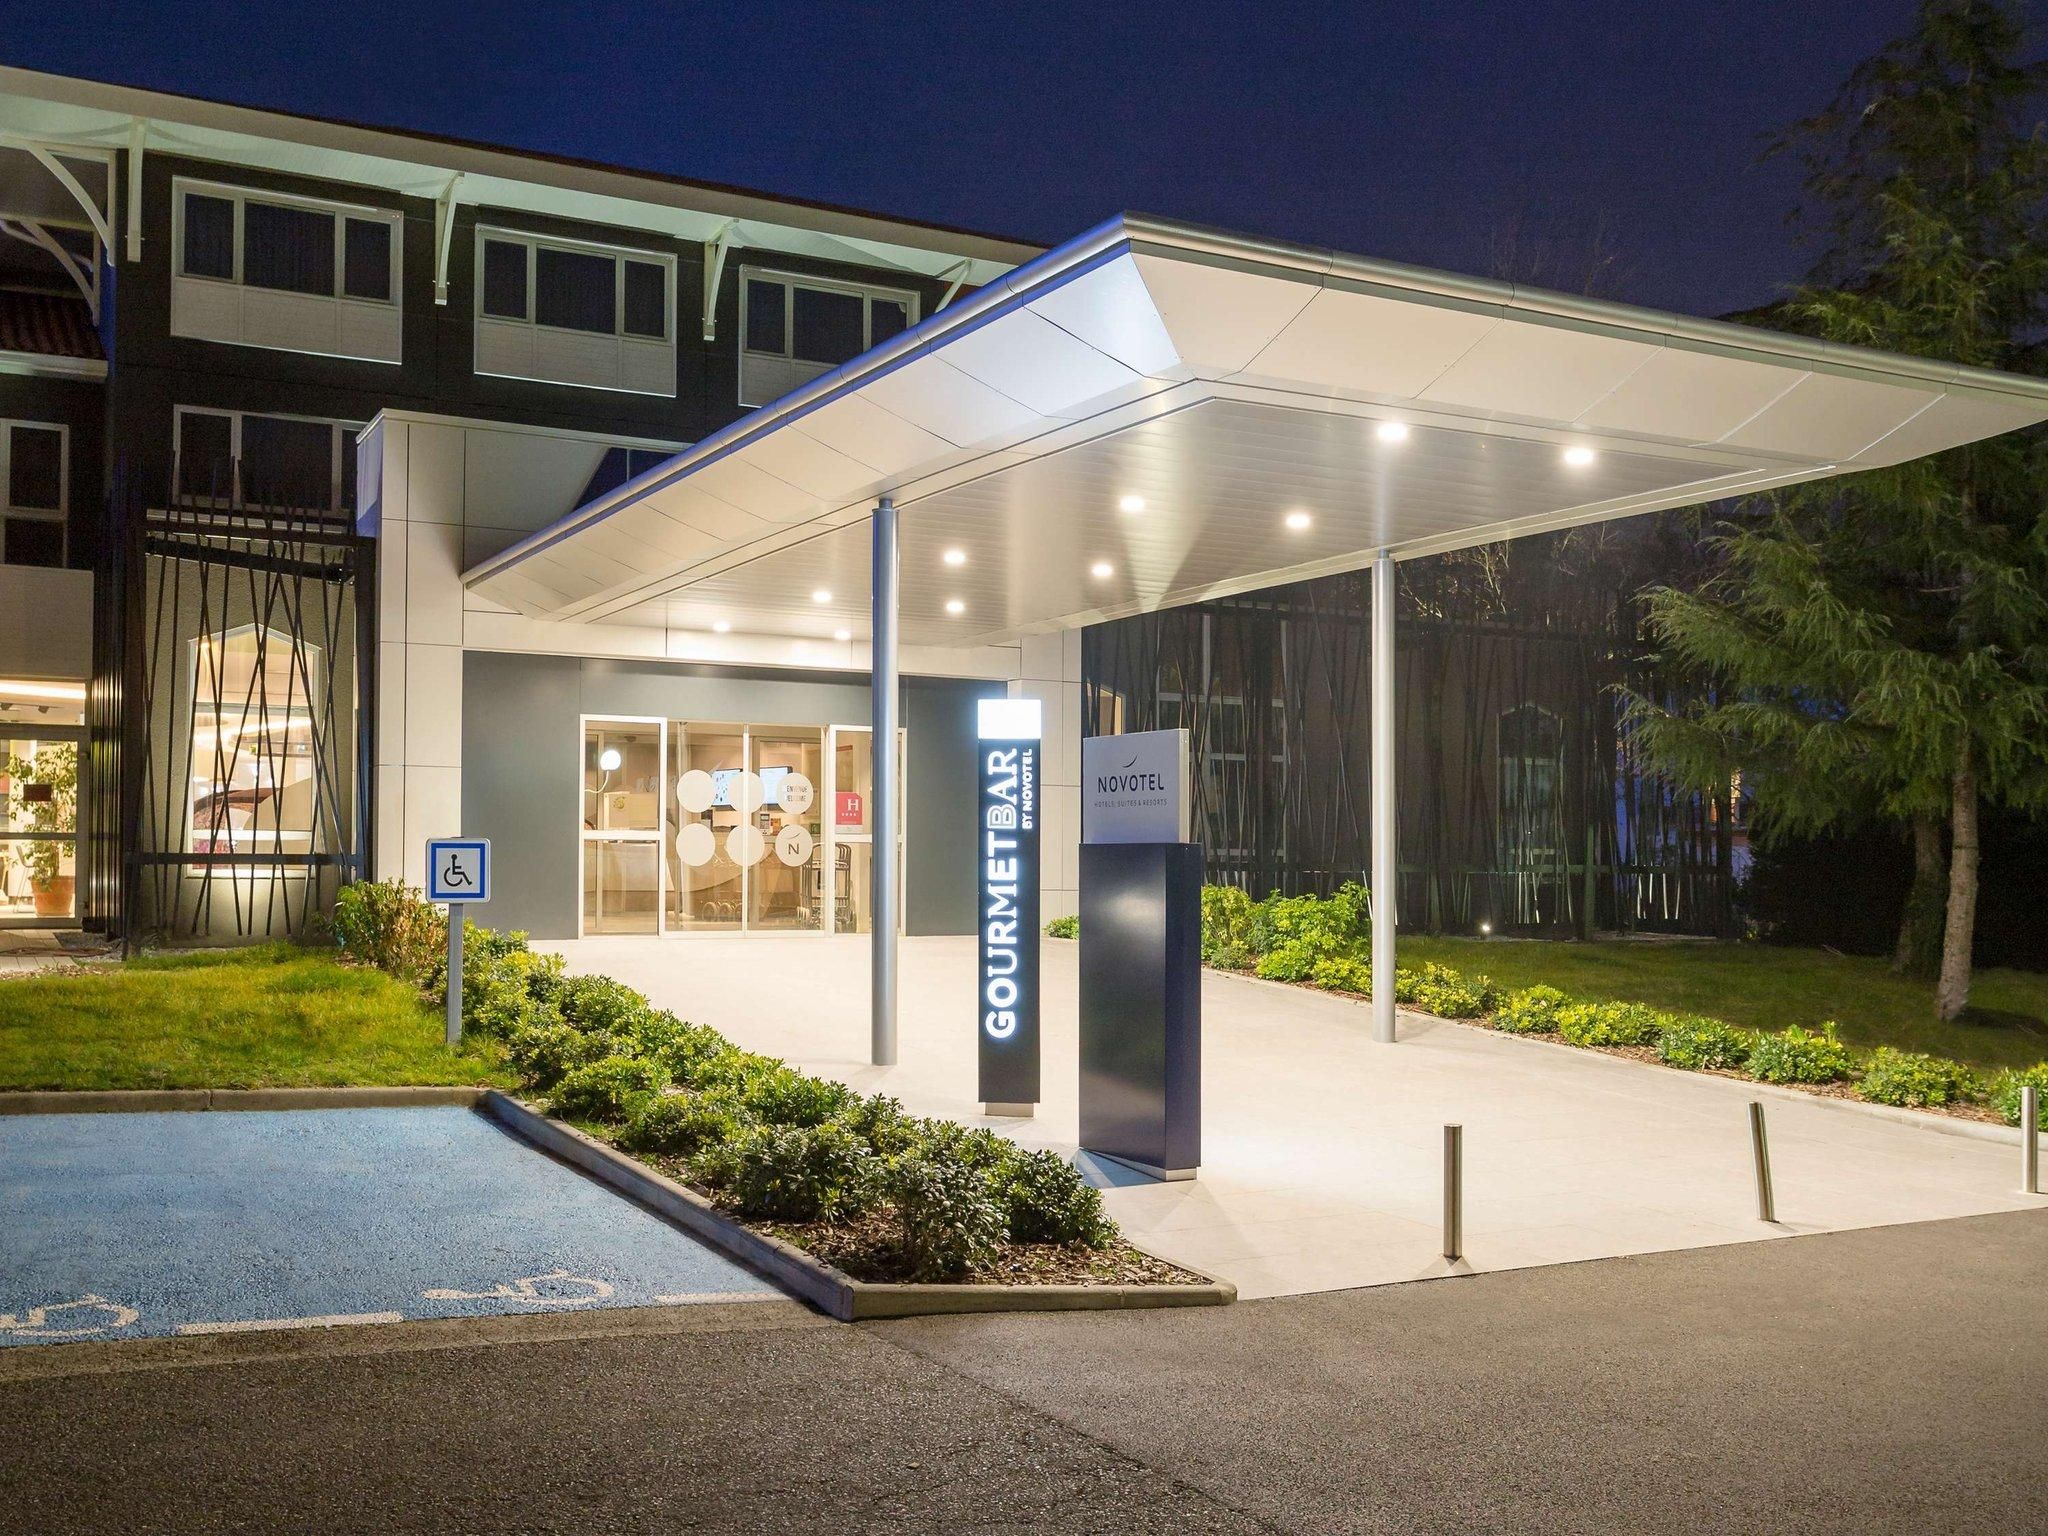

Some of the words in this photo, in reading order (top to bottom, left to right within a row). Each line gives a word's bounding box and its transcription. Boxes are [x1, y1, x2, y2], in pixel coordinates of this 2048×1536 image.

[1022, 748, 1033, 812] NOVOTEL
[1097, 773, 1165, 794] NOVOTEL
[847, 798, 859, 811] H
[1022, 813, 1033, 830] BY
[788, 843, 800, 855] N
